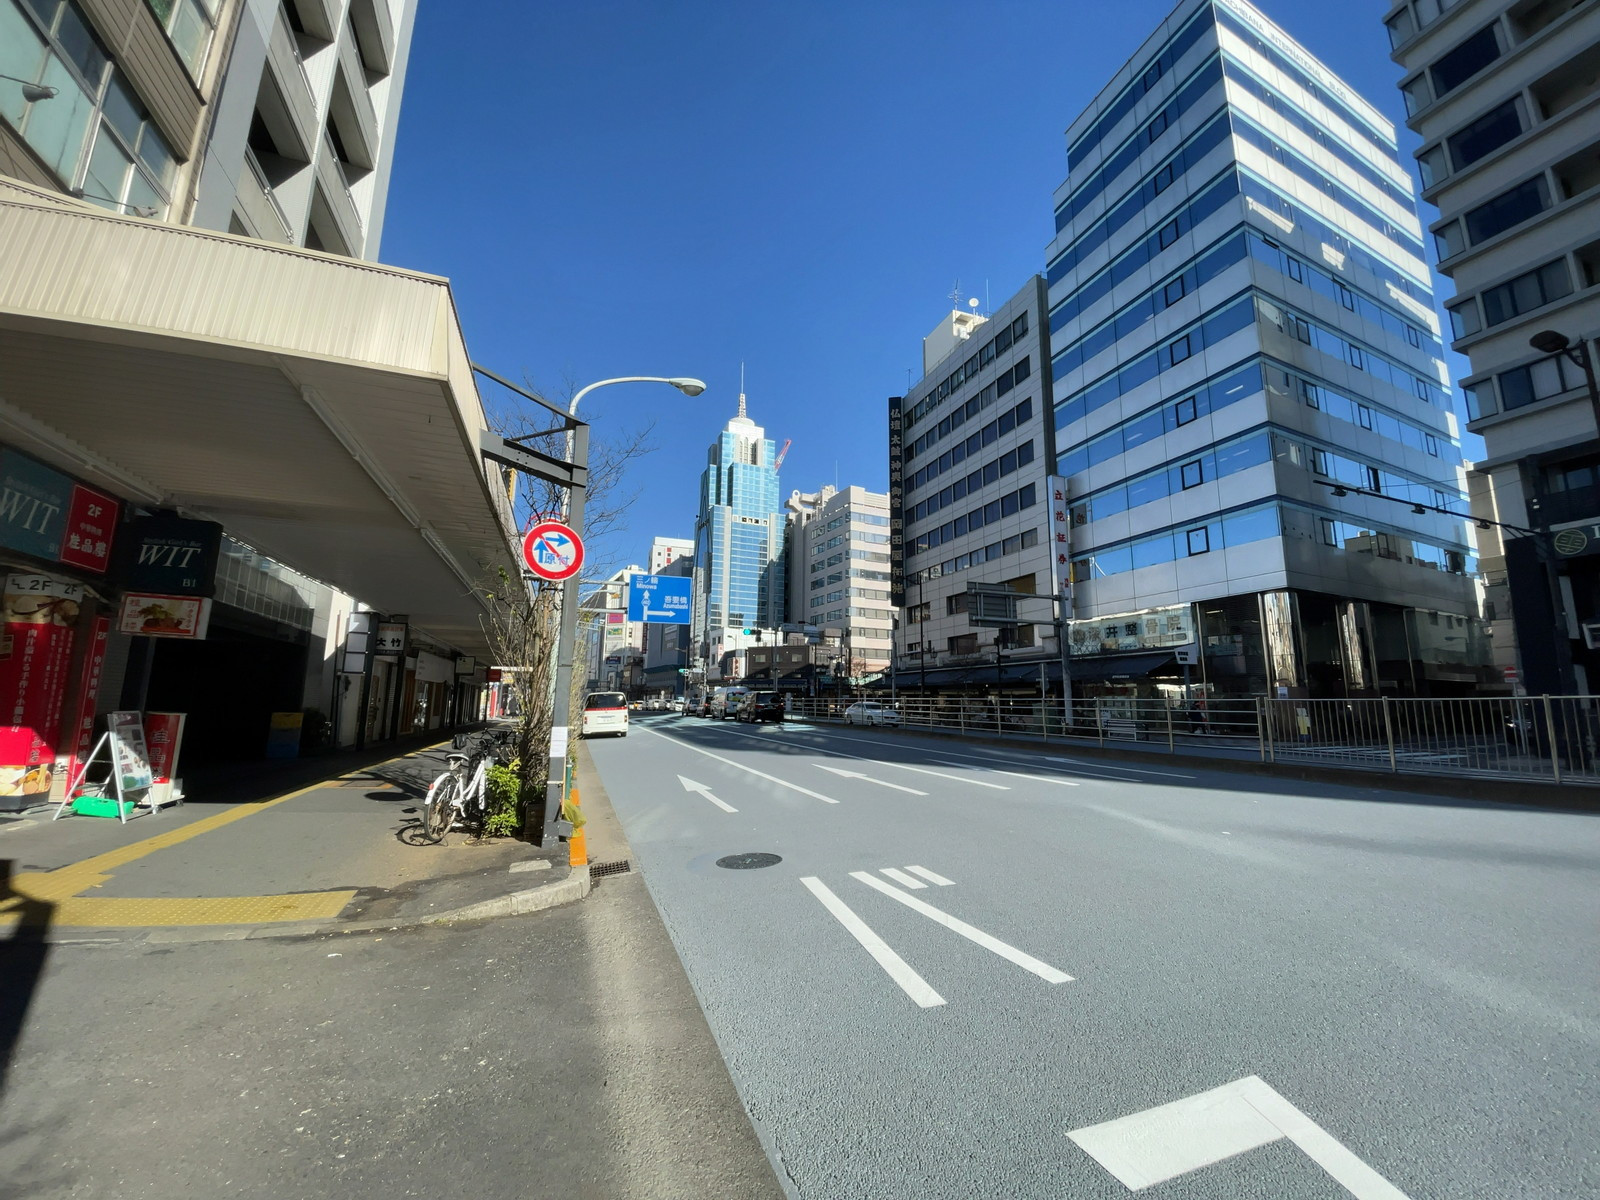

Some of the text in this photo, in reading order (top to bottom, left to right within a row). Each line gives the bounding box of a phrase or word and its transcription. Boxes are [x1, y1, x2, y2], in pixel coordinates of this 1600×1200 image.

[1270, 32, 1324, 81] INTERNATIONAL
[890, 408, 901, 430] 仏壇
[0, 488, 59, 535] WIT
[87, 504, 103, 518] 2F
[1055, 490, 1068, 565] 立花証券
[137, 544, 202, 568] WIT
[544, 553, 570, 566] 原付
[30, 580, 52, 591] 2F
[64, 583, 77, 595] 2F
[182, 578, 197, 588] B1
[376, 637, 402, 647] 大竹
